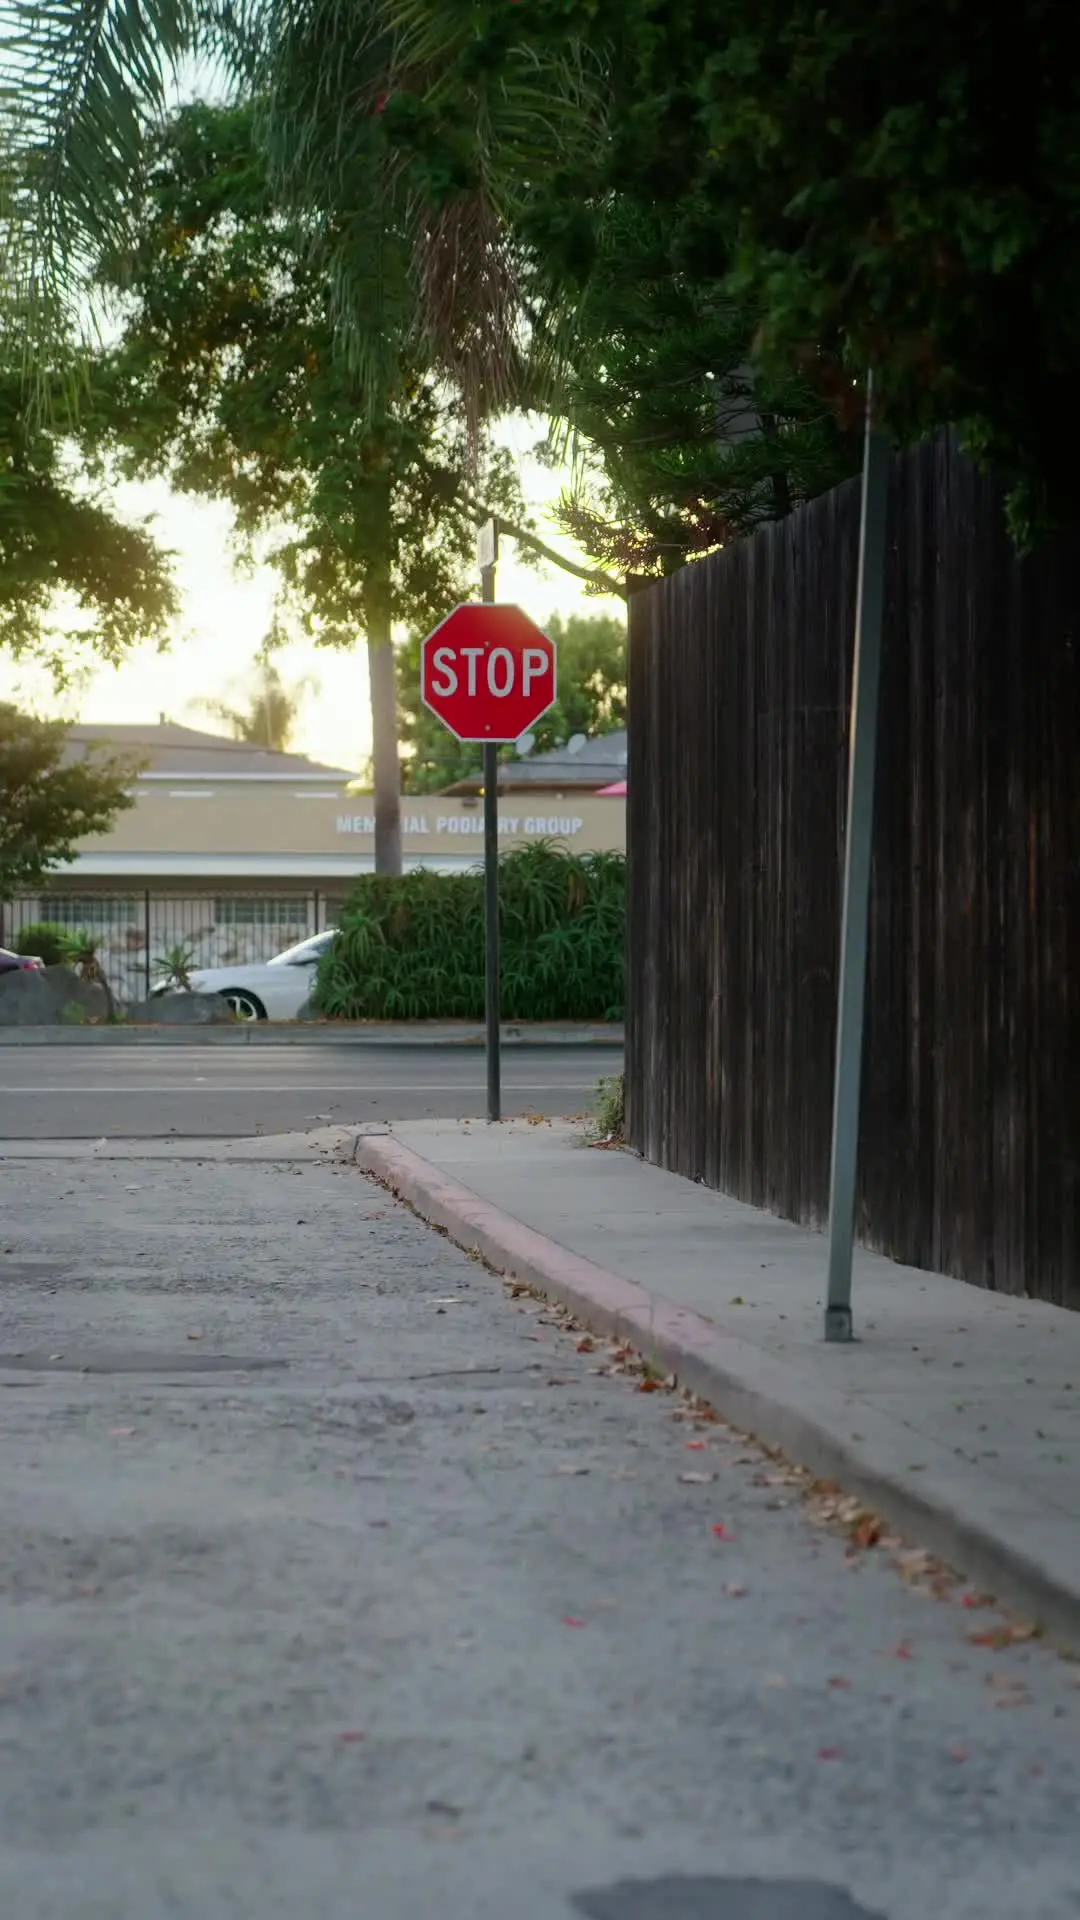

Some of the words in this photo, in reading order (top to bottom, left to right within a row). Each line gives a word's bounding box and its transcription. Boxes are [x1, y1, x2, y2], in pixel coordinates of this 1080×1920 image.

[431, 647, 549, 698] STOP
[336, 815, 431, 834] MEMIAL
[436, 815, 519, 834] PODIARY
[523, 815, 583, 834] GROUP
